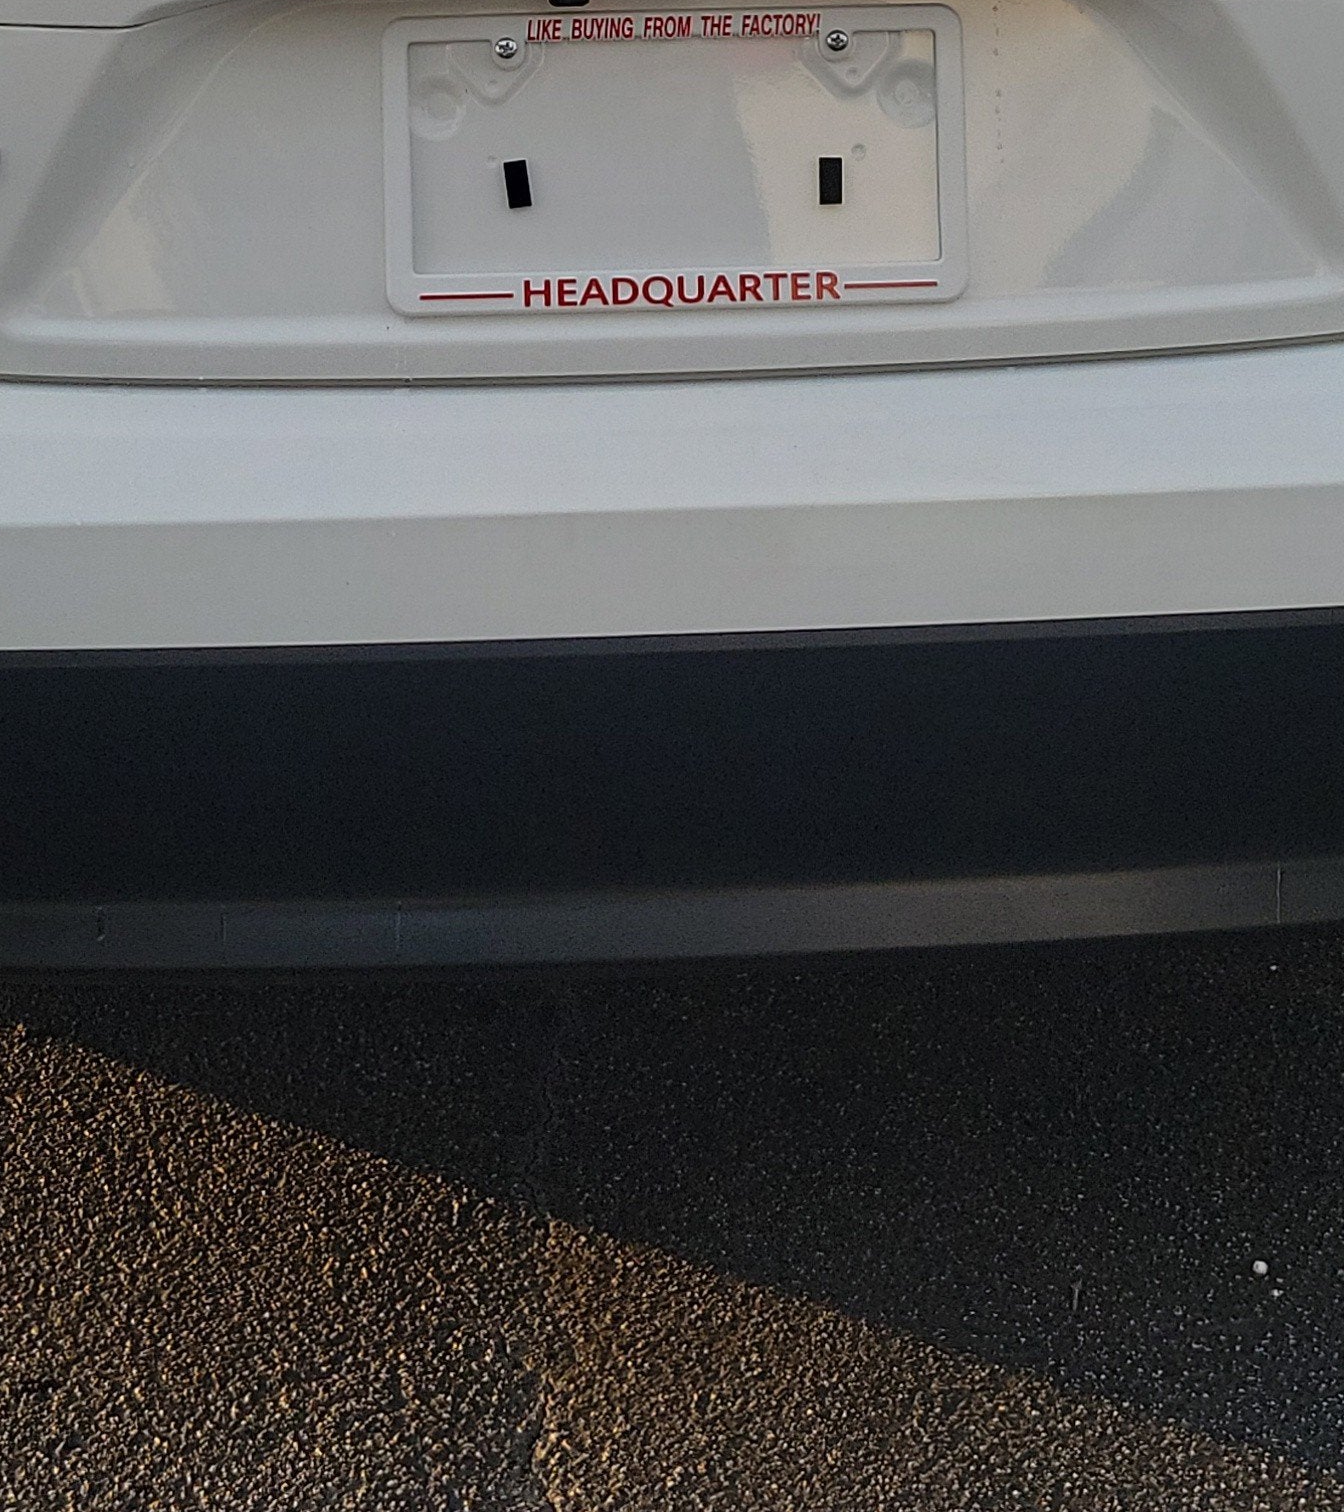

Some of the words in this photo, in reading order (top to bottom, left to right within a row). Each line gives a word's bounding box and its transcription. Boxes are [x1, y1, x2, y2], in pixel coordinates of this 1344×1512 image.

[527, 19, 561, 41] LIKE
[571, 17, 634, 39] BUYING
[643, 16, 691, 38] FROM
[701, 15, 732, 36] THE
[741, 13, 821, 36] FACTORY!
[523, 271, 841, 307] HEADQUARTER
